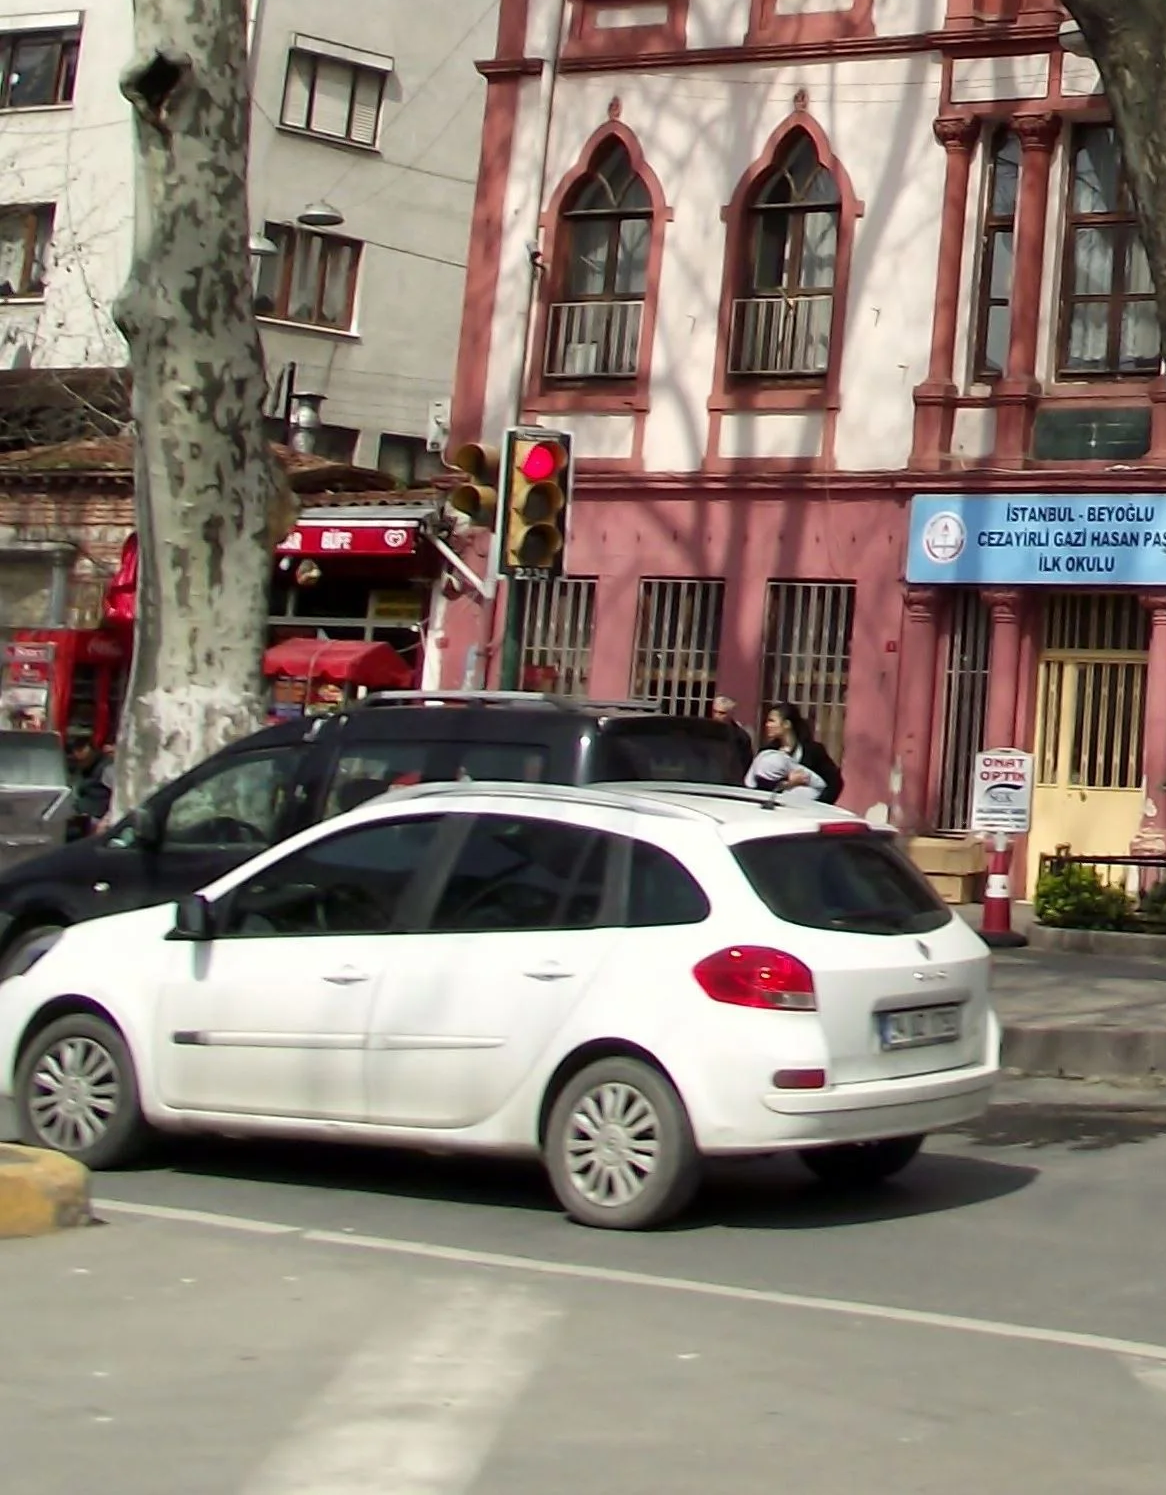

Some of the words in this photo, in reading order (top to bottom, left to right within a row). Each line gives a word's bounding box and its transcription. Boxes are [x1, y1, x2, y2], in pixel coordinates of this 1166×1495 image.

[1006, 502, 1075, 523] İSTANBUL
[1087, 502, 1155, 523] BEYOĞLU
[977, 528, 1050, 547] CEZAYİRLİ
[1053, 528, 1087, 547] GAZİ
[1090, 530, 1139, 547] HASAN
[1038, 554, 1061, 572] İLK
[1065, 556, 1115, 573] OKULU
[983, 758, 1025, 768] ONAT
